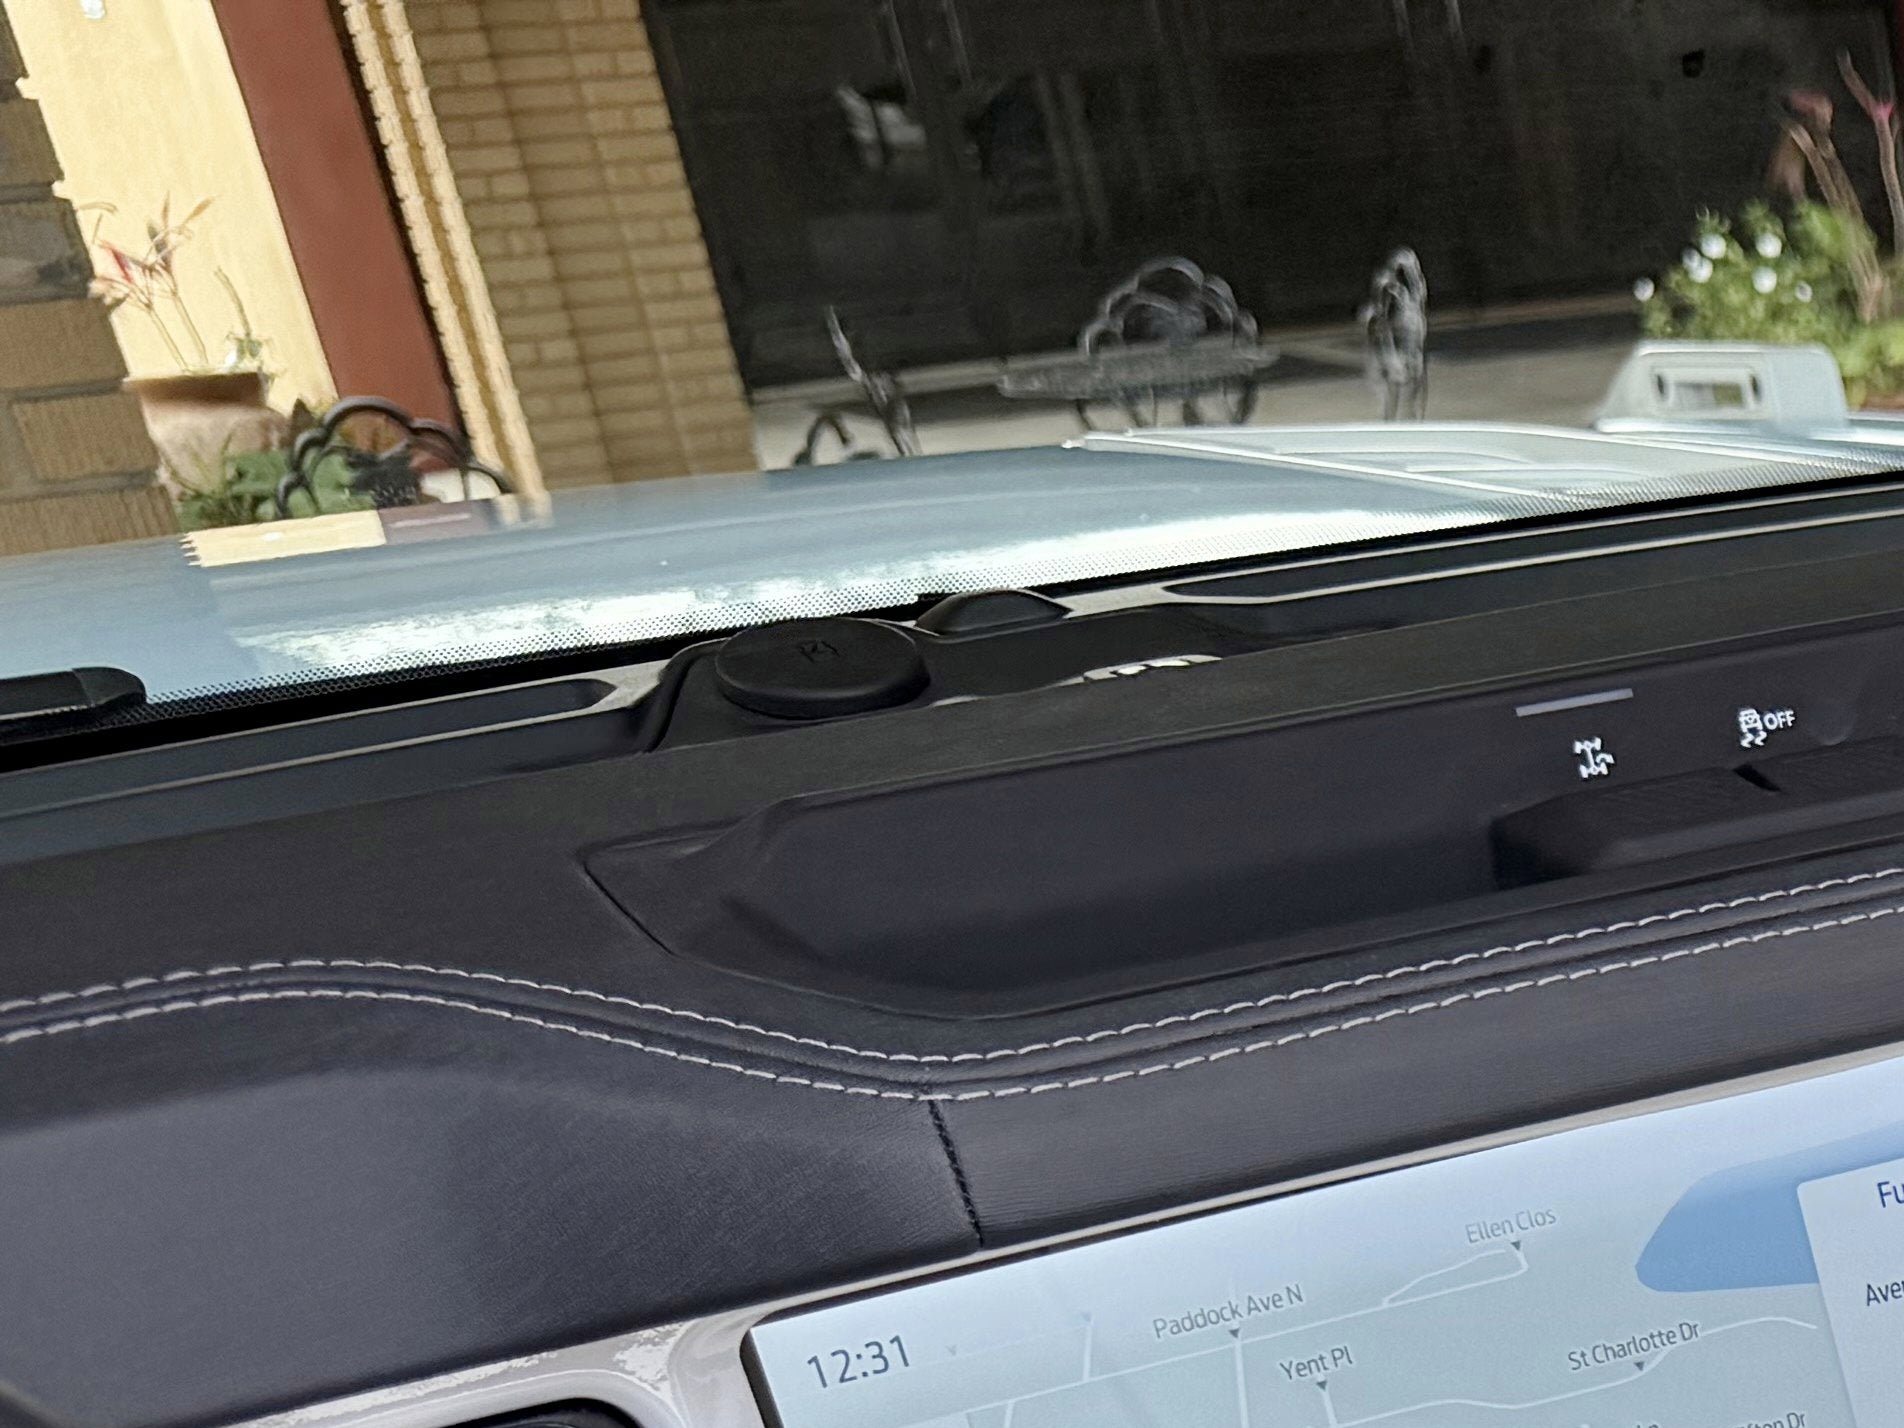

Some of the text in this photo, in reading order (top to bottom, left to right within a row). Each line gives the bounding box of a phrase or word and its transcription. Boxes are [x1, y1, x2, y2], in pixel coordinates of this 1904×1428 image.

[1764, 708, 1796, 729] OFF
[1465, 1207, 1557, 1244] Ellen Clos
[1153, 1284, 1306, 1341] Paddock Ave N
[807, 1334, 911, 1390] 12:31
[1280, 1346, 1353, 1382] Yent Pl
[1568, 1321, 1701, 1371] St Charlotte Dr
